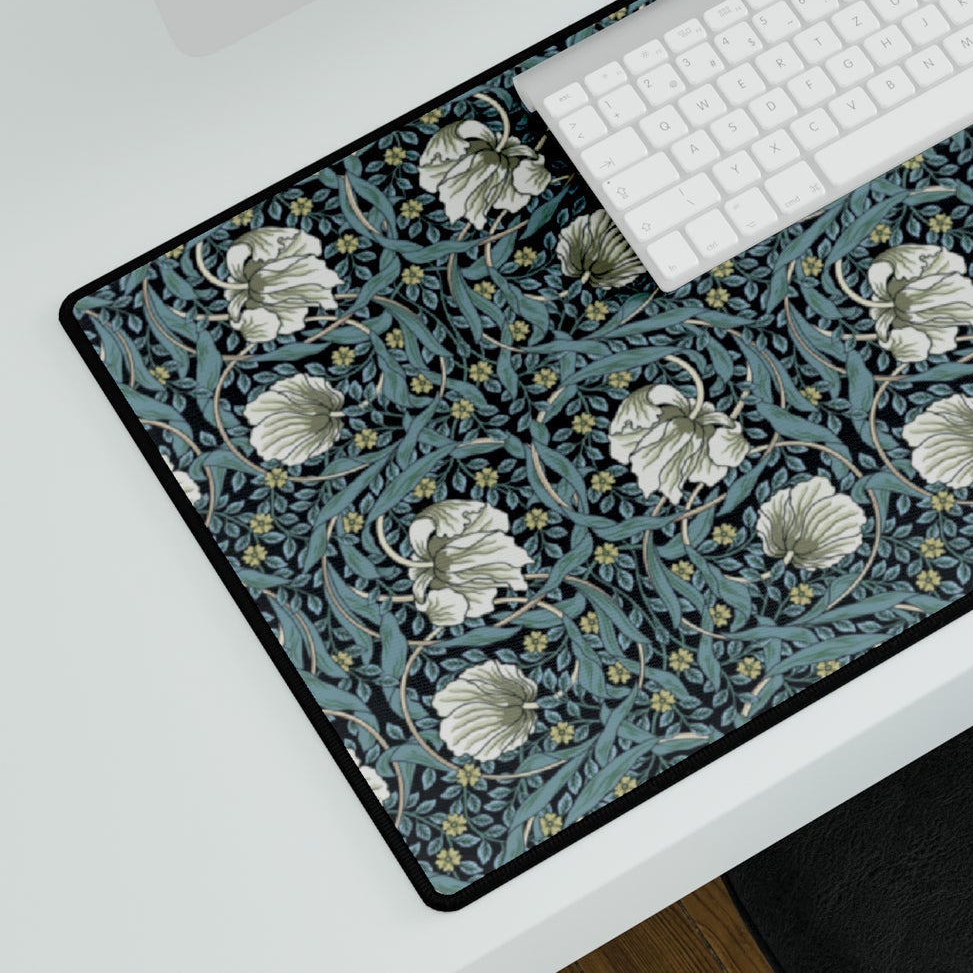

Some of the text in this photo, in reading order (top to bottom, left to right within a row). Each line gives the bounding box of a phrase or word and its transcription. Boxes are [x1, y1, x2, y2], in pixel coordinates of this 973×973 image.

[604, 100, 612, 109] 1
[644, 79, 653, 88] 2
[682, 58, 691, 67] 3
[722, 37, 730, 46] 4
[759, 16, 768, 25] 5
[659, 121, 671, 132] Q
[695, 98, 710, 111] W
[737, 78, 747, 90] E
[775, 58, 786, 68] R
[813, 36, 823, 46] T
[851, 15, 863, 27] Z
[689, 143, 700, 155] A
[727, 122, 738, 132] S
[765, 100, 777, 112] D
[804, 79, 813, 90] F
[842, 58, 854, 69] G
[880, 37, 893, 49] H
[921, 17, 929, 28] J
[730, 163, 740, 174] Y
[768, 142, 782, 154] X
[808, 121, 820, 132] C
[846, 99, 857, 111] V
[885, 79, 896, 90] B
[922, 58, 935, 69] N
[960, 36, 973, 49] M
